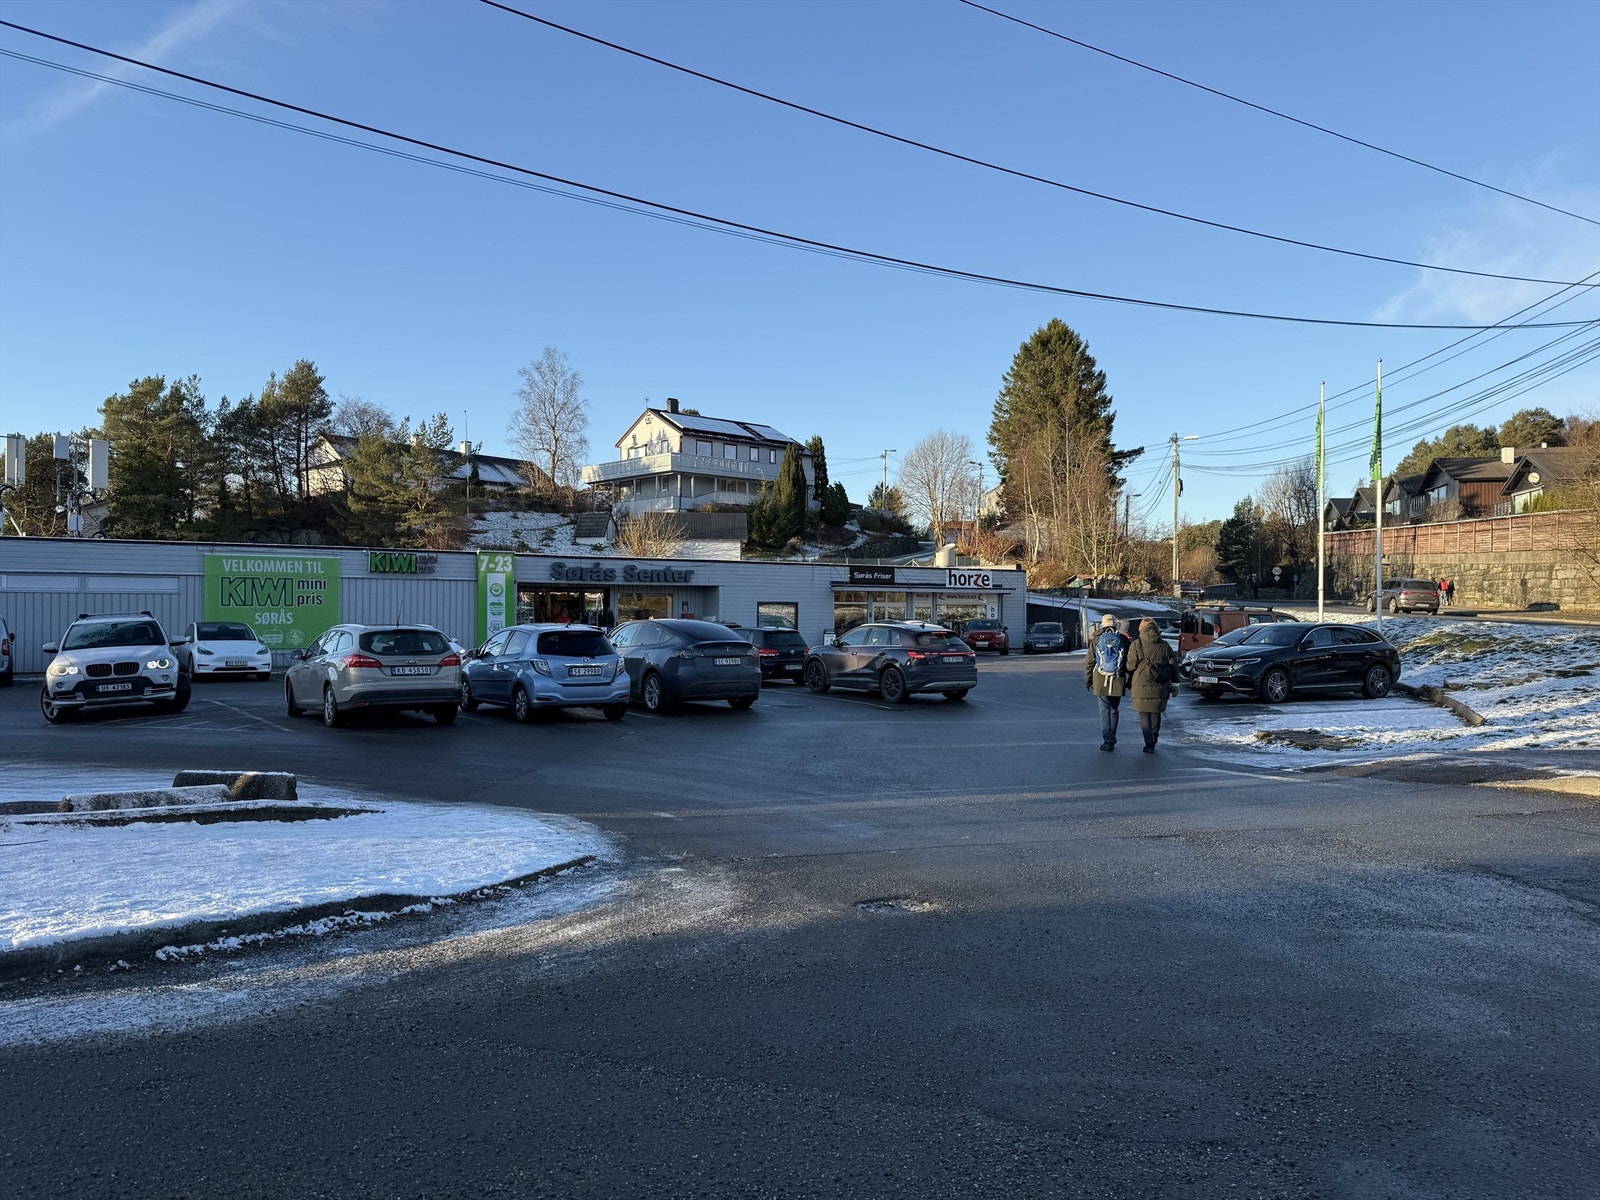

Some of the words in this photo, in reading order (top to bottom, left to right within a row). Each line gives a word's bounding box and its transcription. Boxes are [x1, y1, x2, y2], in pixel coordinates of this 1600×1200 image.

[222, 559, 303, 573] VELKOMMEN
[305, 561, 325, 574] TIL
[369, 552, 417, 573] KIWI
[479, 555, 513, 573] 7-23
[550, 561, 617, 582] Sørås
[623, 564, 695, 583] Senter
[948, 569, 990, 588] horze
[220, 576, 294, 607] KIWI
[297, 577, 327, 590] mini
[297, 592, 324, 608] pris
[254, 608, 294, 625] SØRÅS
[396, 666, 406, 674] KB
